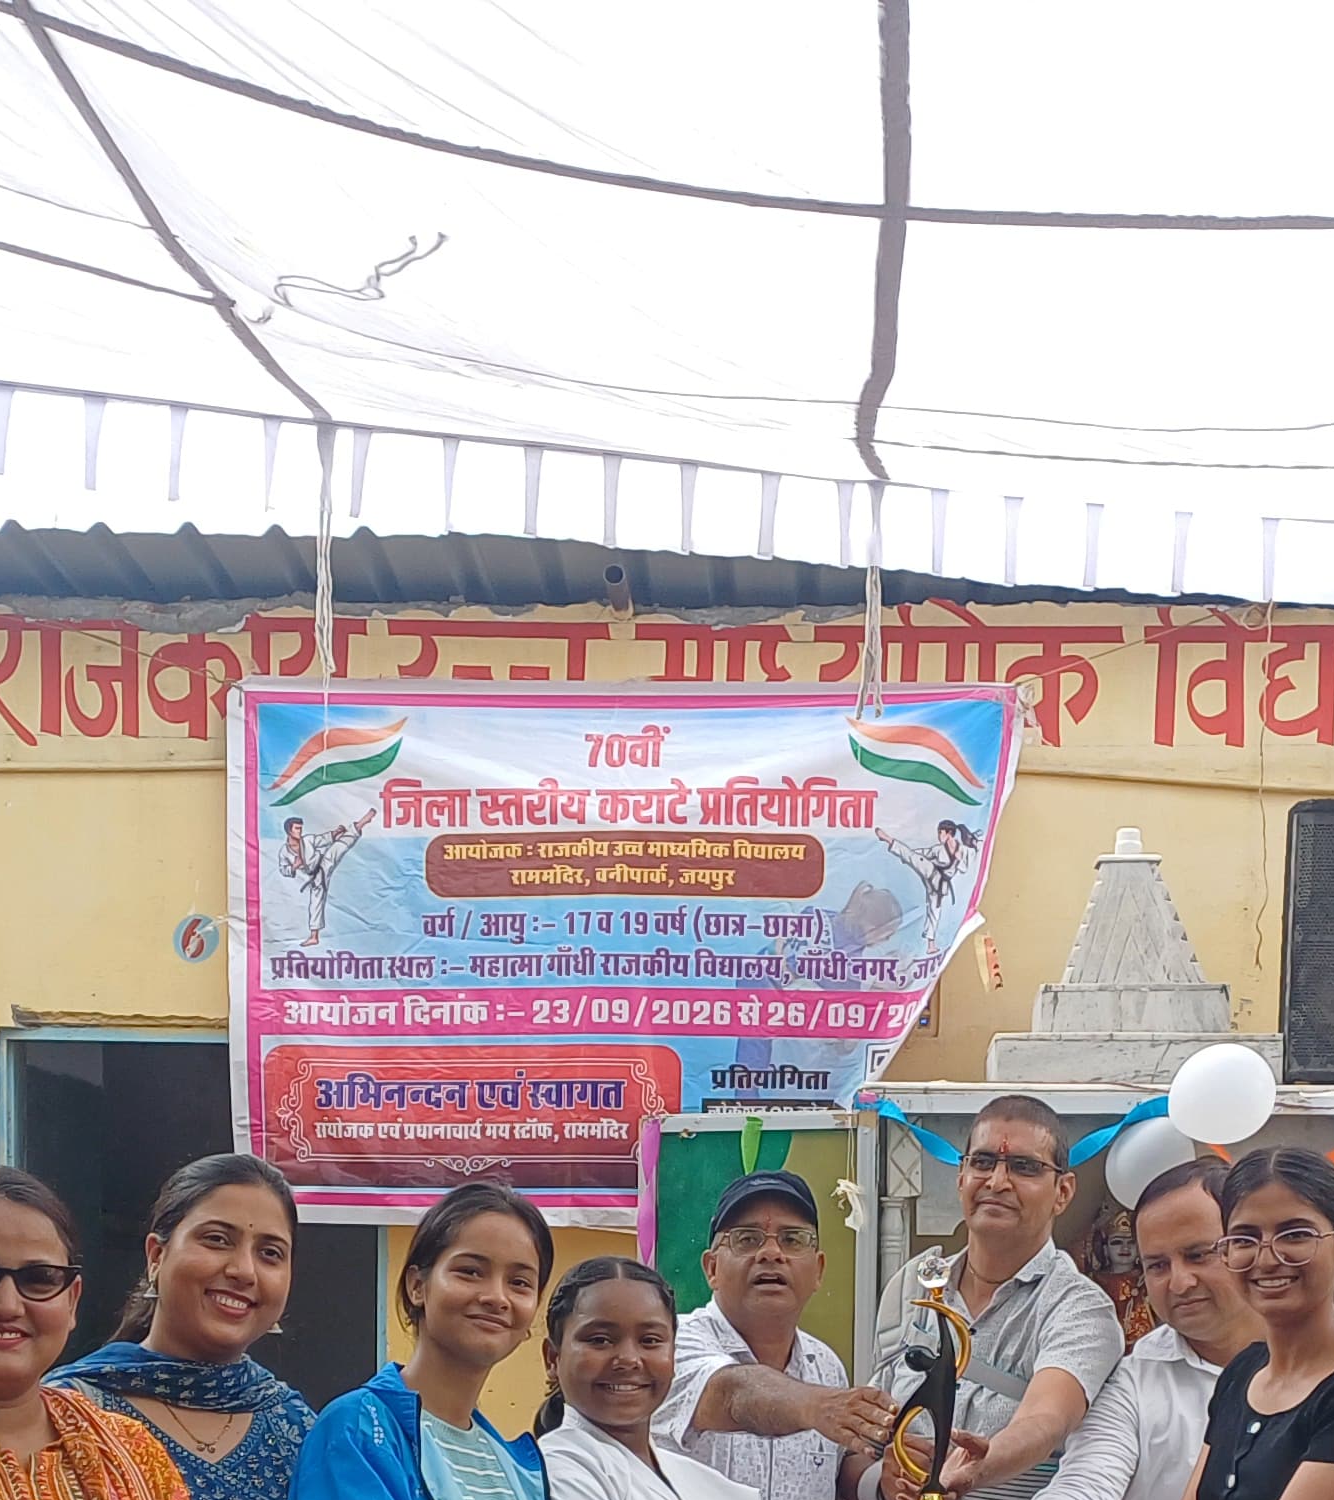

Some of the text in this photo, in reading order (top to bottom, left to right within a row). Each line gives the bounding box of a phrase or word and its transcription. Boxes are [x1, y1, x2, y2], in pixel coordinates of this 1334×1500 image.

[584, 724, 671, 768] 70वीं
[379, 775, 879, 829] जिला स्तरीय कराटे प्रतियोगिता
[443, 839, 524, 861] आयोजक
[537, 837, 610, 859] राजकीय
[647, 838, 731, 858] माध्यमिक
[733, 838, 807, 861] विद्यालय
[678, 868, 736, 891] जयपुर
[181, 918, 205, 958] 6
[421, 907, 456, 938] वर्ग
[480, 912, 527, 945] आयु
[563, 911, 592, 935] 17
[595, 911, 614, 935] व
[619, 911, 648, 935] 19
[653, 905, 688, 936] वर्ष
[269, 950, 385, 981] प्रतियोगिता
[386, 955, 436, 979] स्थल
[468, 954, 543, 978] महात्मा
[546, 946, 597, 978] गाँधी
[599, 947, 691, 978] राजकीय
[694, 949, 791, 986] विद्यालय,
[796, 948, 848, 981] गाँधी
[850, 957, 907, 987] नगर,
[282, 994, 399, 1026] आयोजन
[402, 993, 489, 1026] दिनांक
[531, 996, 732, 1028] 23/09/2026
[738, 994, 763, 1028] से
[315, 1069, 627, 1110] अभिनन्दन एवं स्वागत
[711, 1064, 831, 1092] प्रतियोगिता
[314, 1116, 375, 1140] संयोजक
[377, 1117, 403, 1140] एवं
[403, 1118, 483, 1141] प्रधानाचार्य
[562, 1117, 631, 1140] राममंदिर
